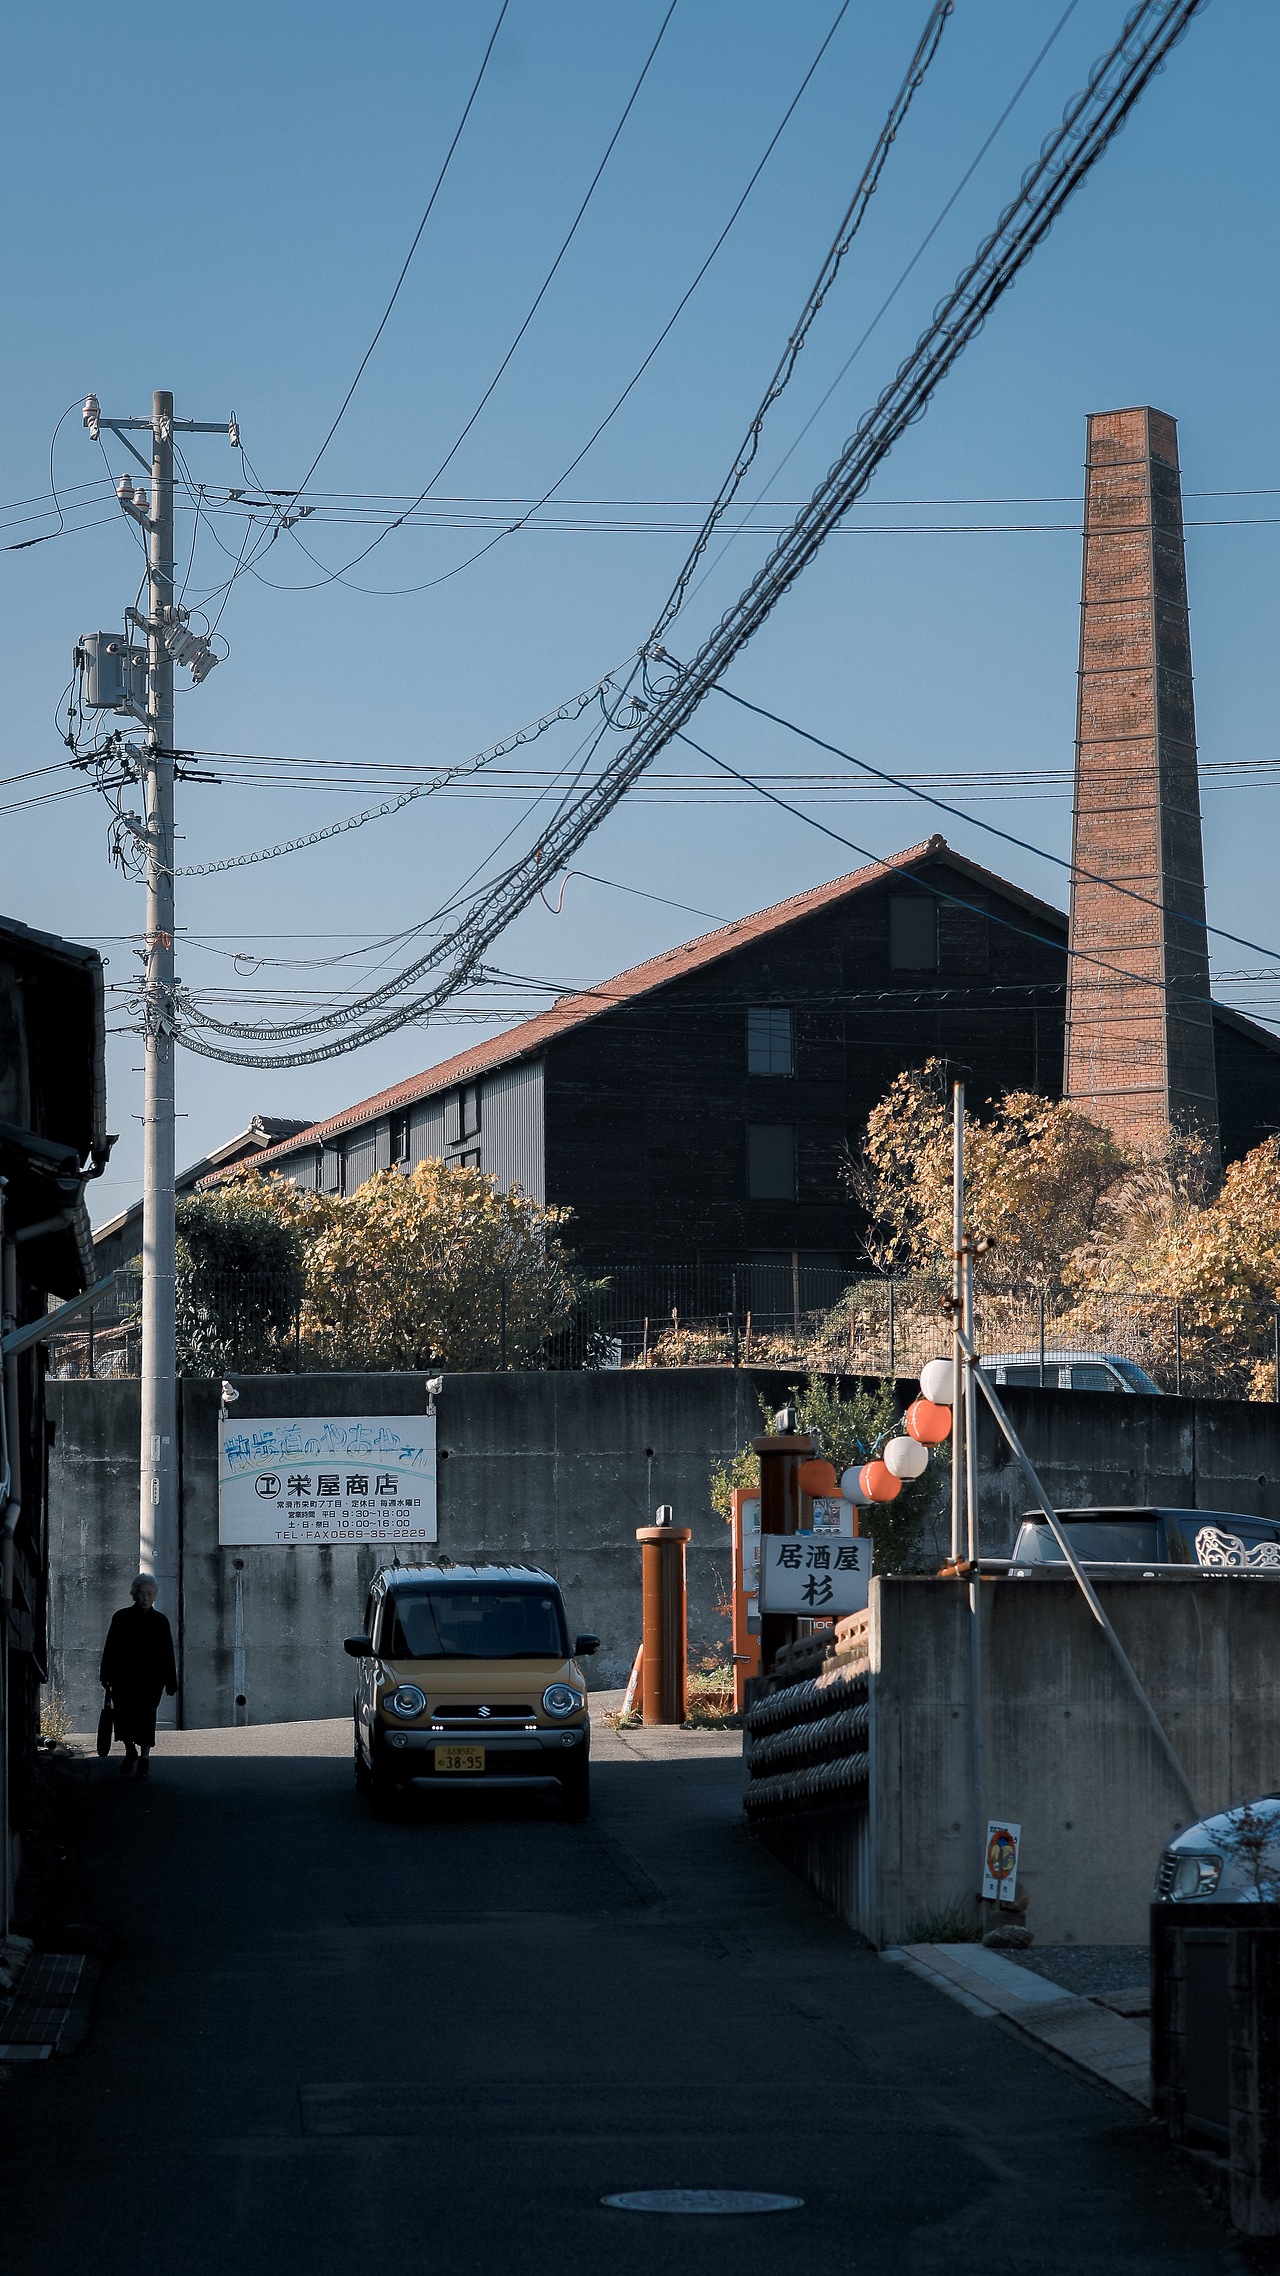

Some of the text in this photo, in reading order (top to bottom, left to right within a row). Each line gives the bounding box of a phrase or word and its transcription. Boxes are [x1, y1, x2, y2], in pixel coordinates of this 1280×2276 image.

[287, 1473, 399, 1497] 栄屋商店
[776, 1543, 861, 1572] 居酒屋
[801, 1574, 834, 1607] 杉
[446, 1756, 482, 1769] 38-95
